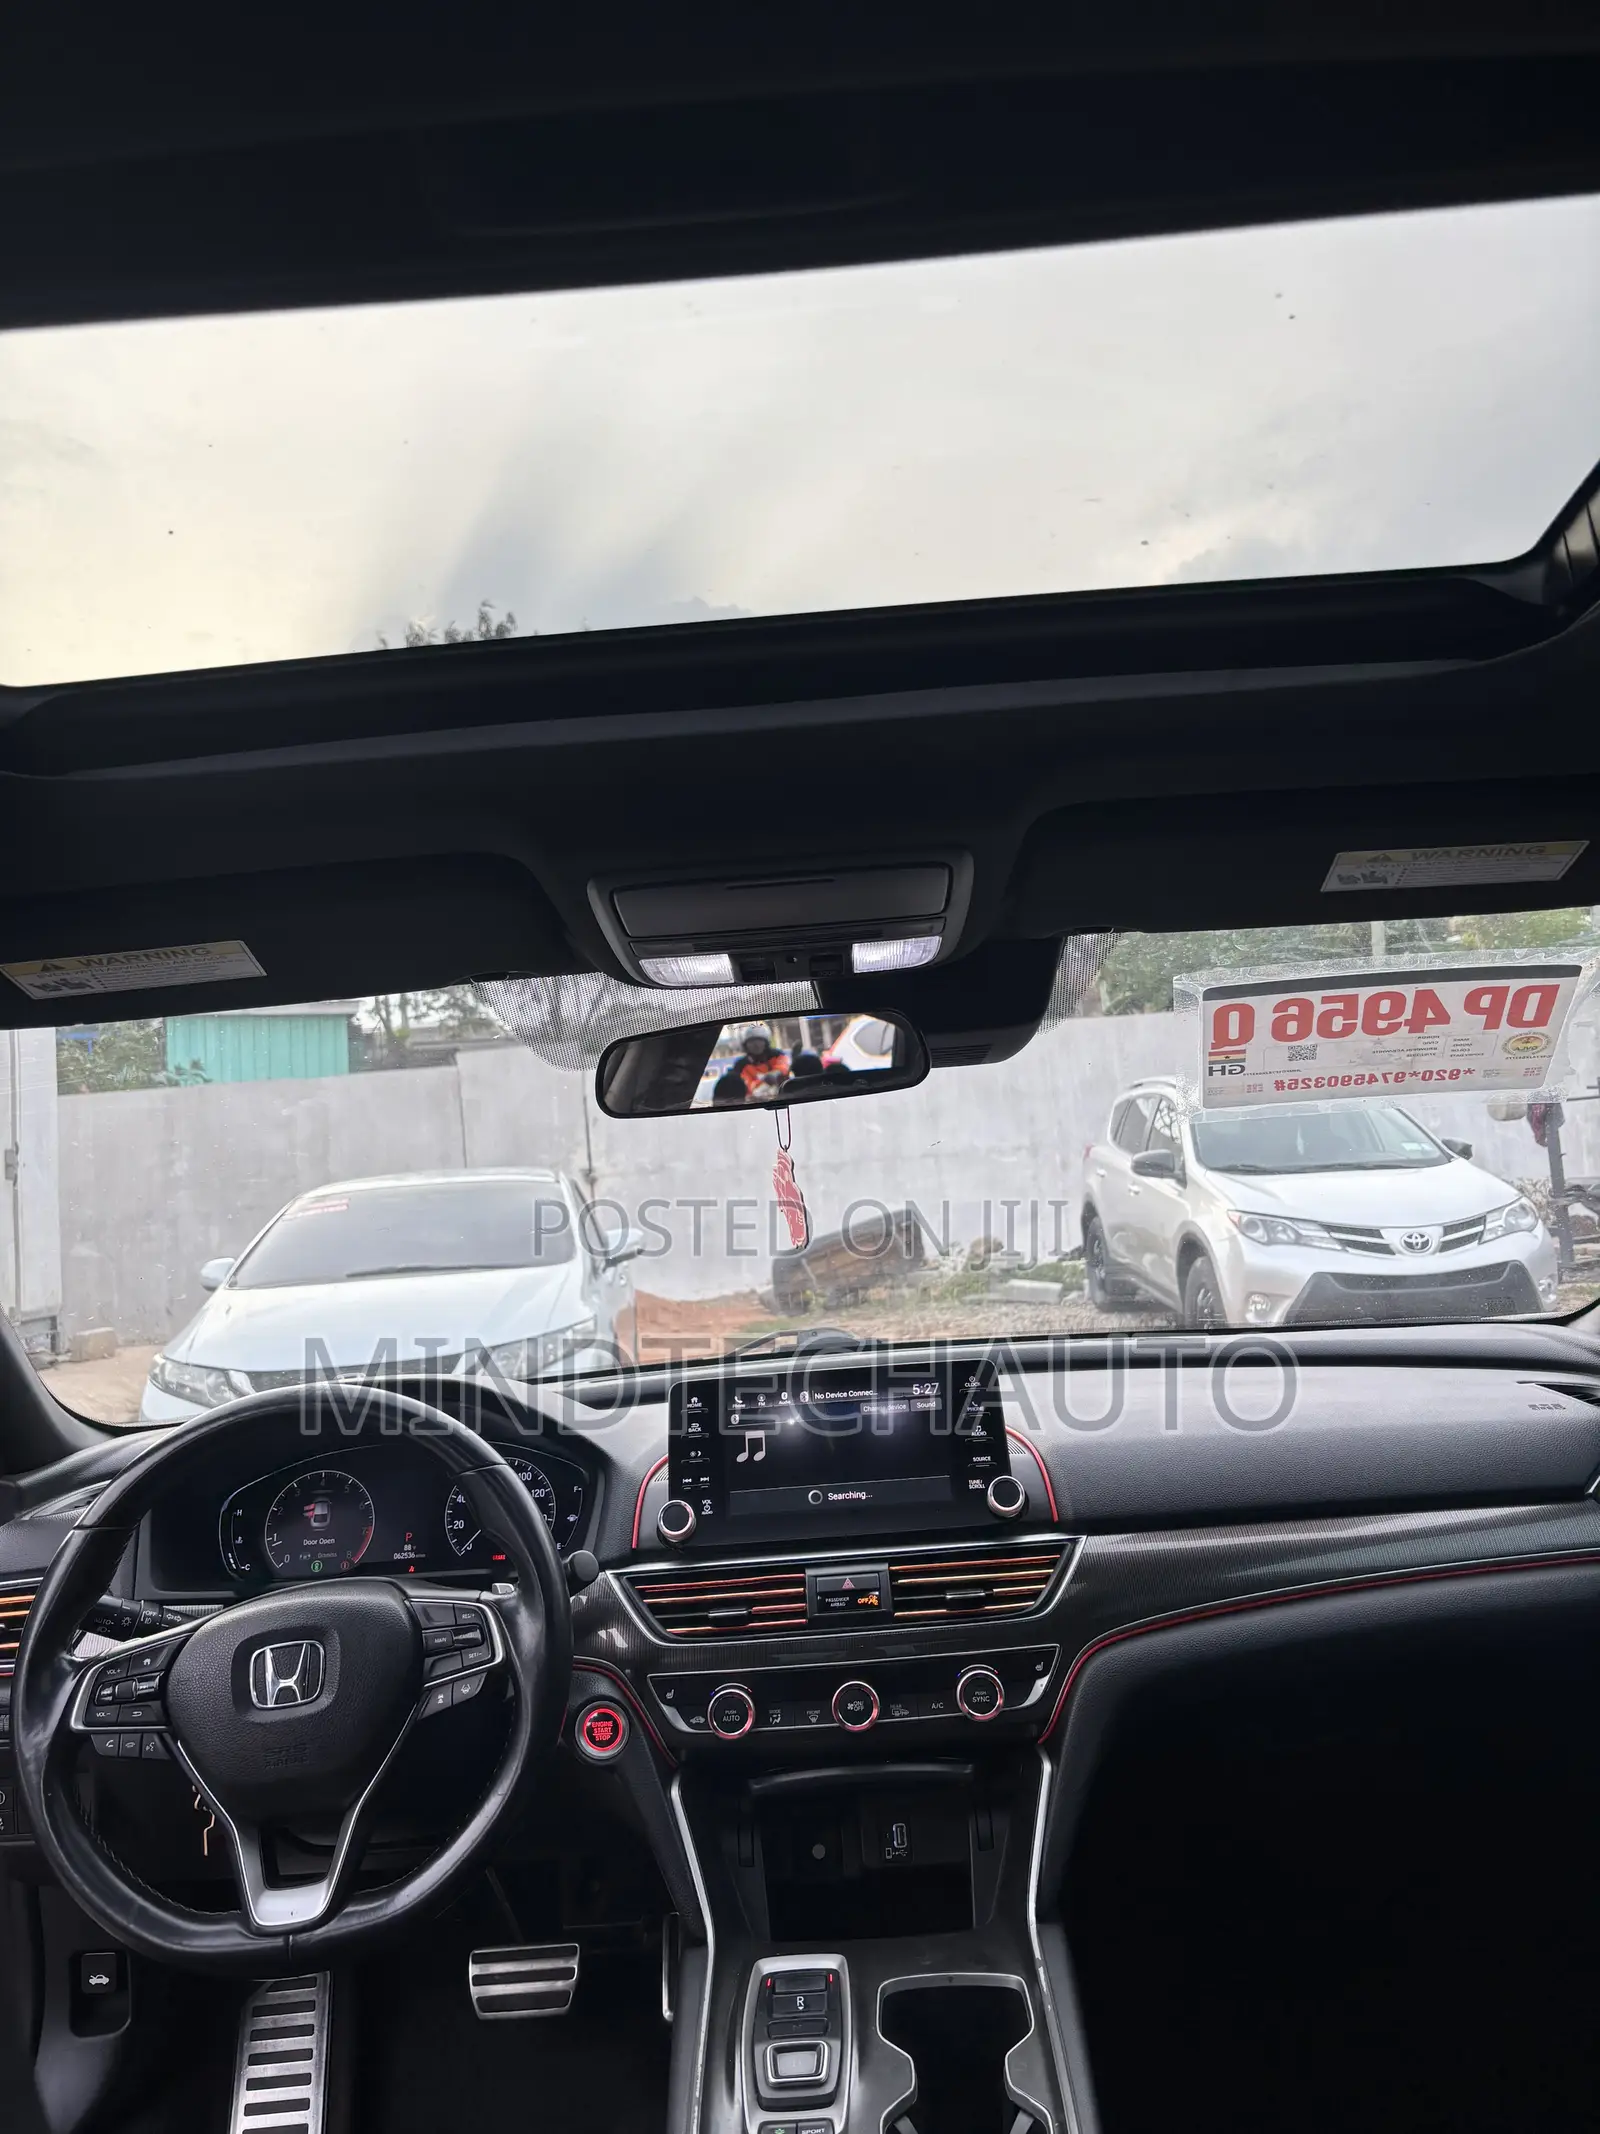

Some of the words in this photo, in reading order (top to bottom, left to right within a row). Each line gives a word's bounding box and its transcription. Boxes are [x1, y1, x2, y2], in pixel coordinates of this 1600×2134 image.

[1411, 844, 1548, 861] WARNING
[77, 946, 213, 967] WARNING
[912, 1382, 939, 1395] 5:27
[814, 1391, 825, 1400] No
[825, 1390, 847, 1399] Device
[887, 1402, 907, 1410] device
[916, 1401, 936, 1409] Sound
[531, 1488, 545, 1498] 120
[827, 1490, 873, 1501] Searching...
[453, 1520, 465, 1529] 20
[303, 1538, 318, 1546] Door
[319, 1537, 335, 1546] Open
[393, 1551, 416, 1560] 062536
[972, 1695, 990, 1703] SYNC
[722, 1714, 741, 1722] AUTO
[591, 1720, 613, 1728] ENGINE
[595, 1733, 611, 1741] STOP
[796, 1995, 805, 2007] R
